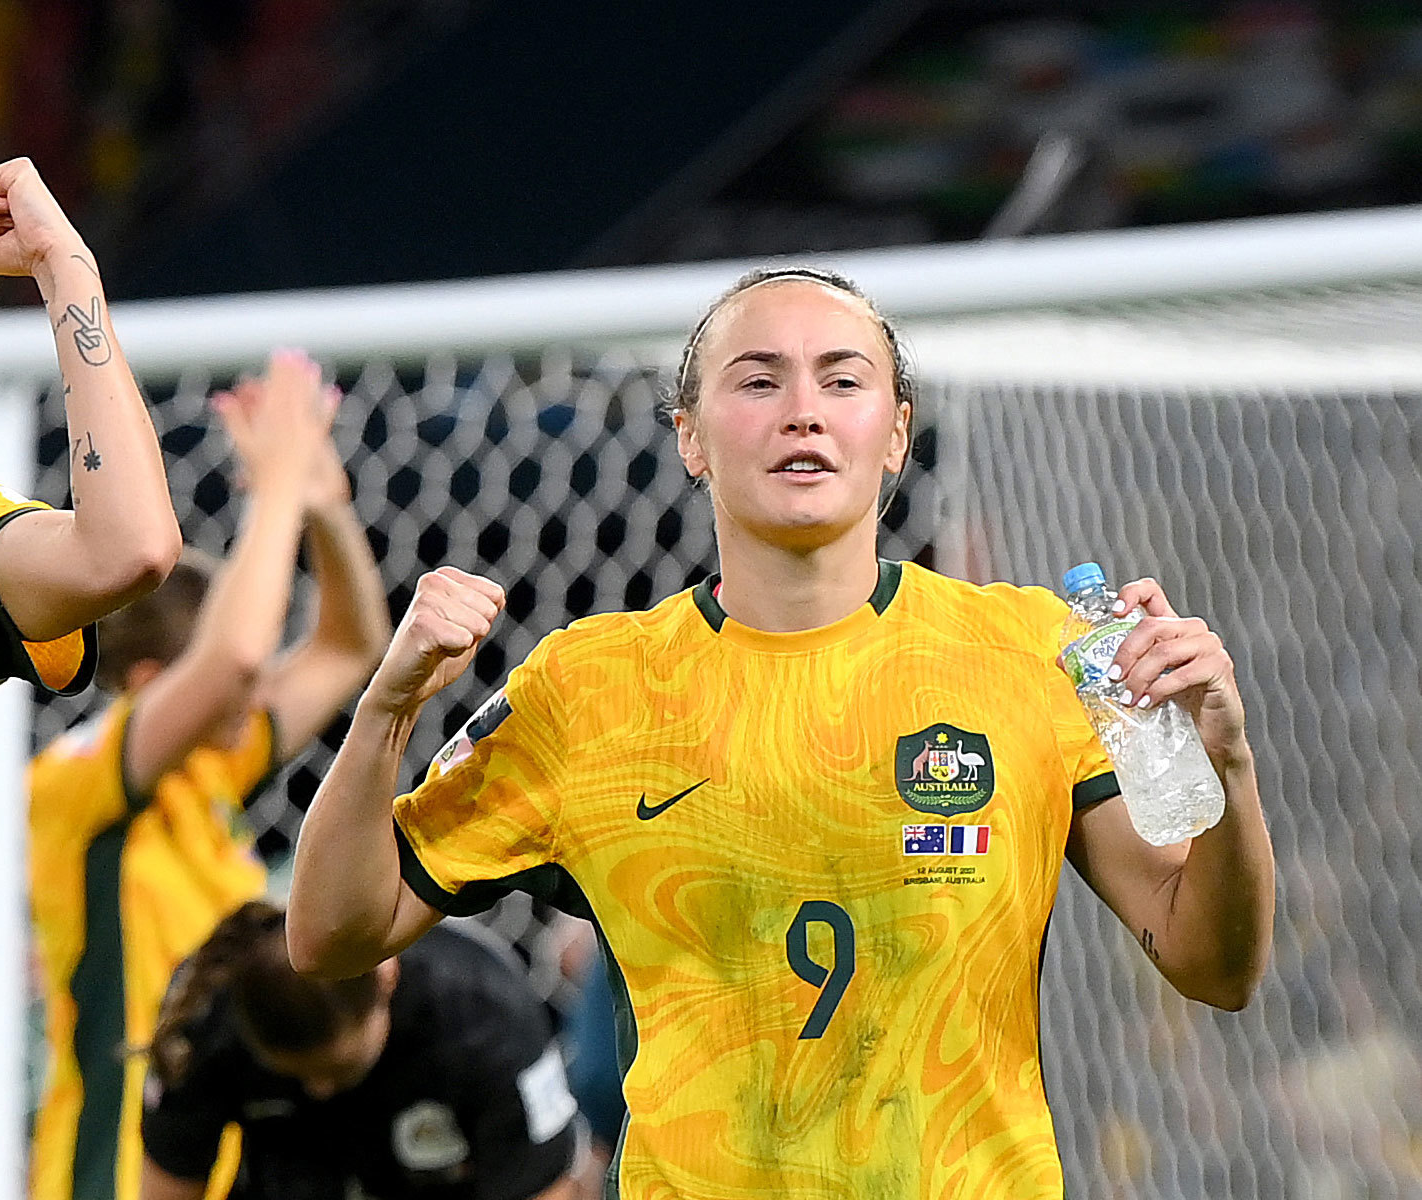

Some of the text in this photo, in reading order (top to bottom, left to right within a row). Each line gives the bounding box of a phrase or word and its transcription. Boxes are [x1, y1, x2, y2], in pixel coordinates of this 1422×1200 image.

[913, 782, 978, 792] AUSTRALIA
[927, 866, 958, 874] AUGUST
[785, 900, 855, 1040] 9
